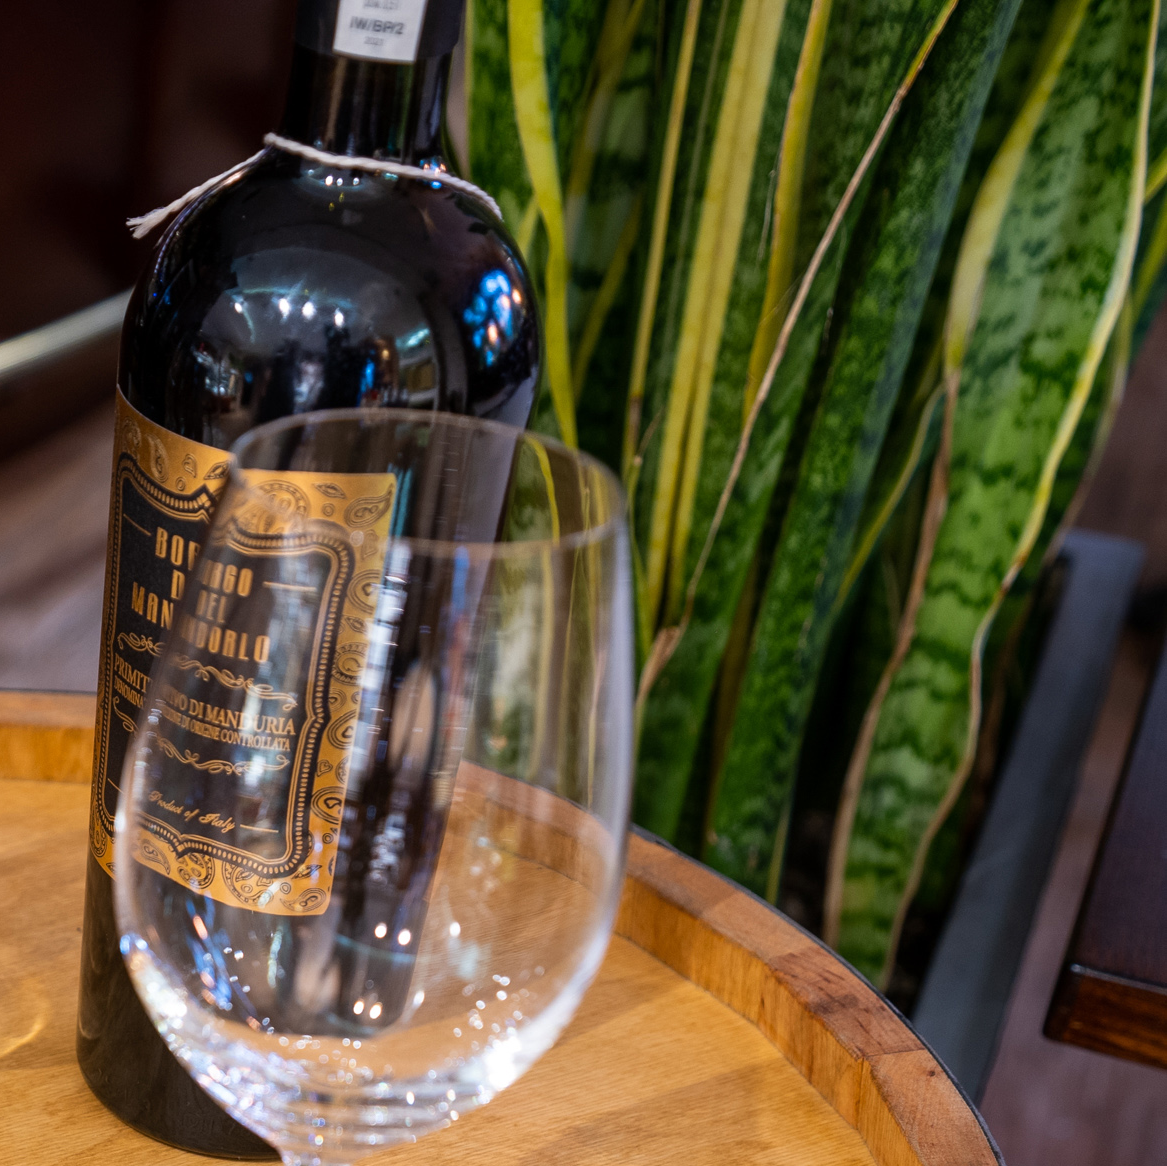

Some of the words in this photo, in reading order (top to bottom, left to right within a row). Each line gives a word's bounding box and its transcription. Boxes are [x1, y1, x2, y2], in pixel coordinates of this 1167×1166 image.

[188, 698, 205, 718] DI
[205, 704, 296, 735] MANDURIA
[220, 729, 290, 752] CONTROLLATA
[149, 790, 184, 814] Product
[184, 809, 200, 822] of
[199, 813, 235, 833] Italy
